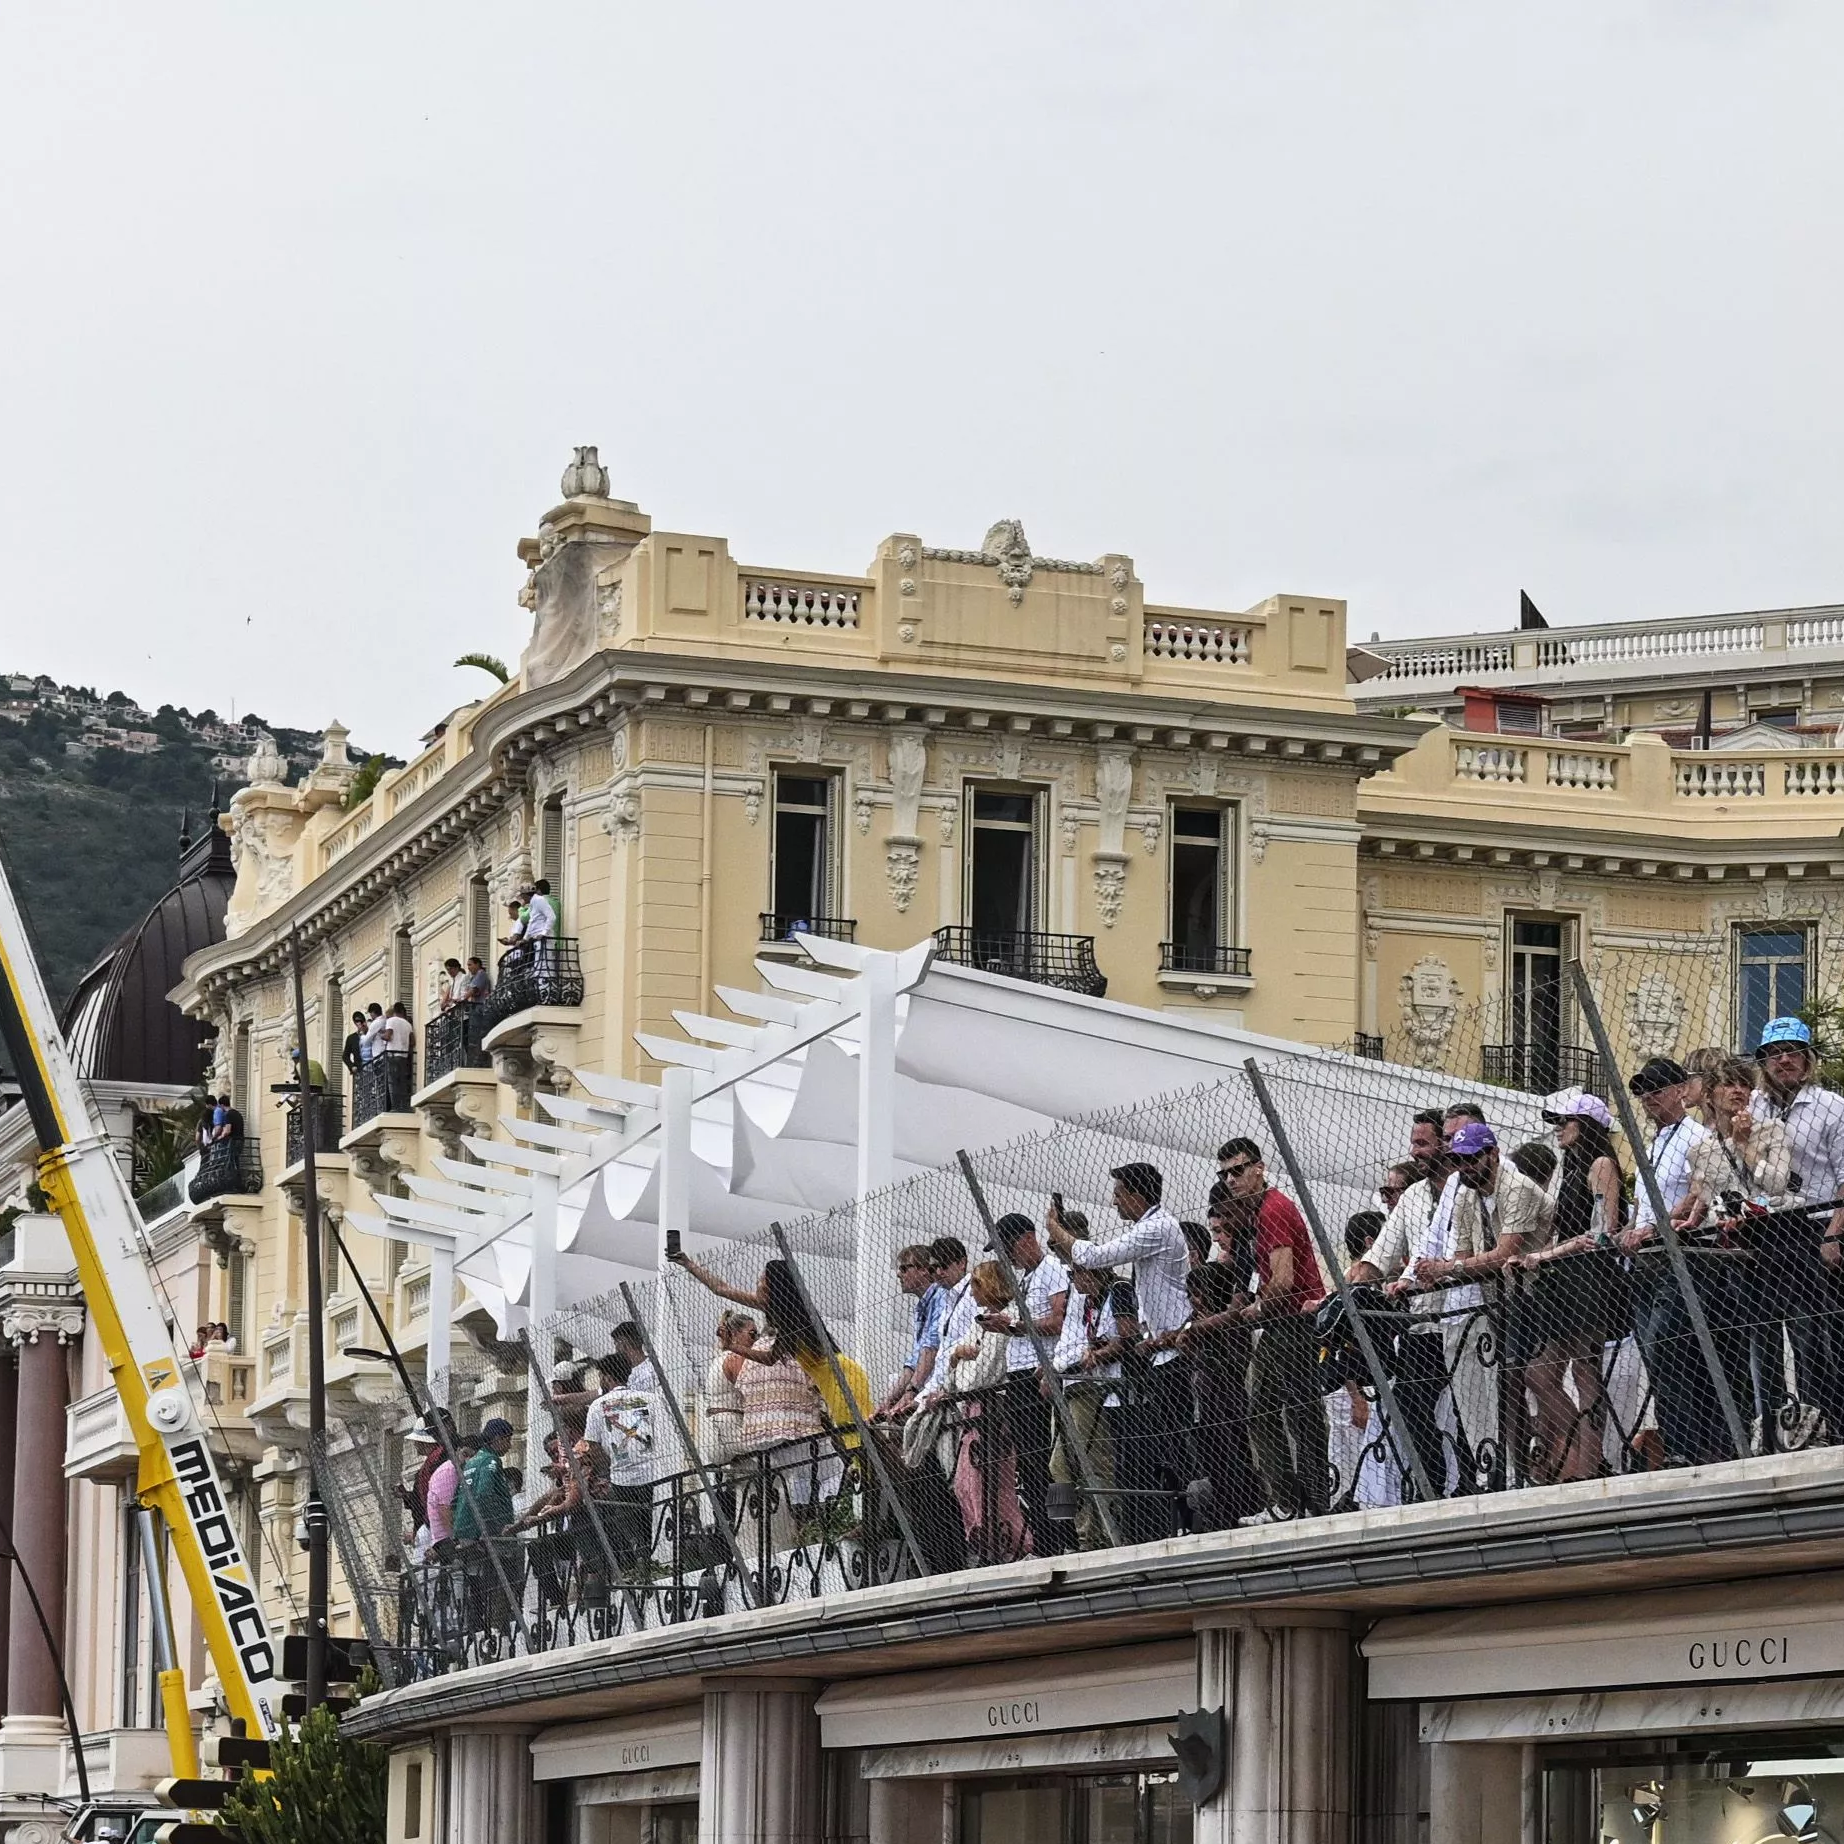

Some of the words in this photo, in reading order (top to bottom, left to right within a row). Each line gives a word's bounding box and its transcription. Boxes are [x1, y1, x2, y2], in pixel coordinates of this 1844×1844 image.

[1688, 1637, 1788, 1670] GUCCI
[987, 1702, 1040, 1727] GUCCI
[621, 1744, 650, 1764] GUCCI
